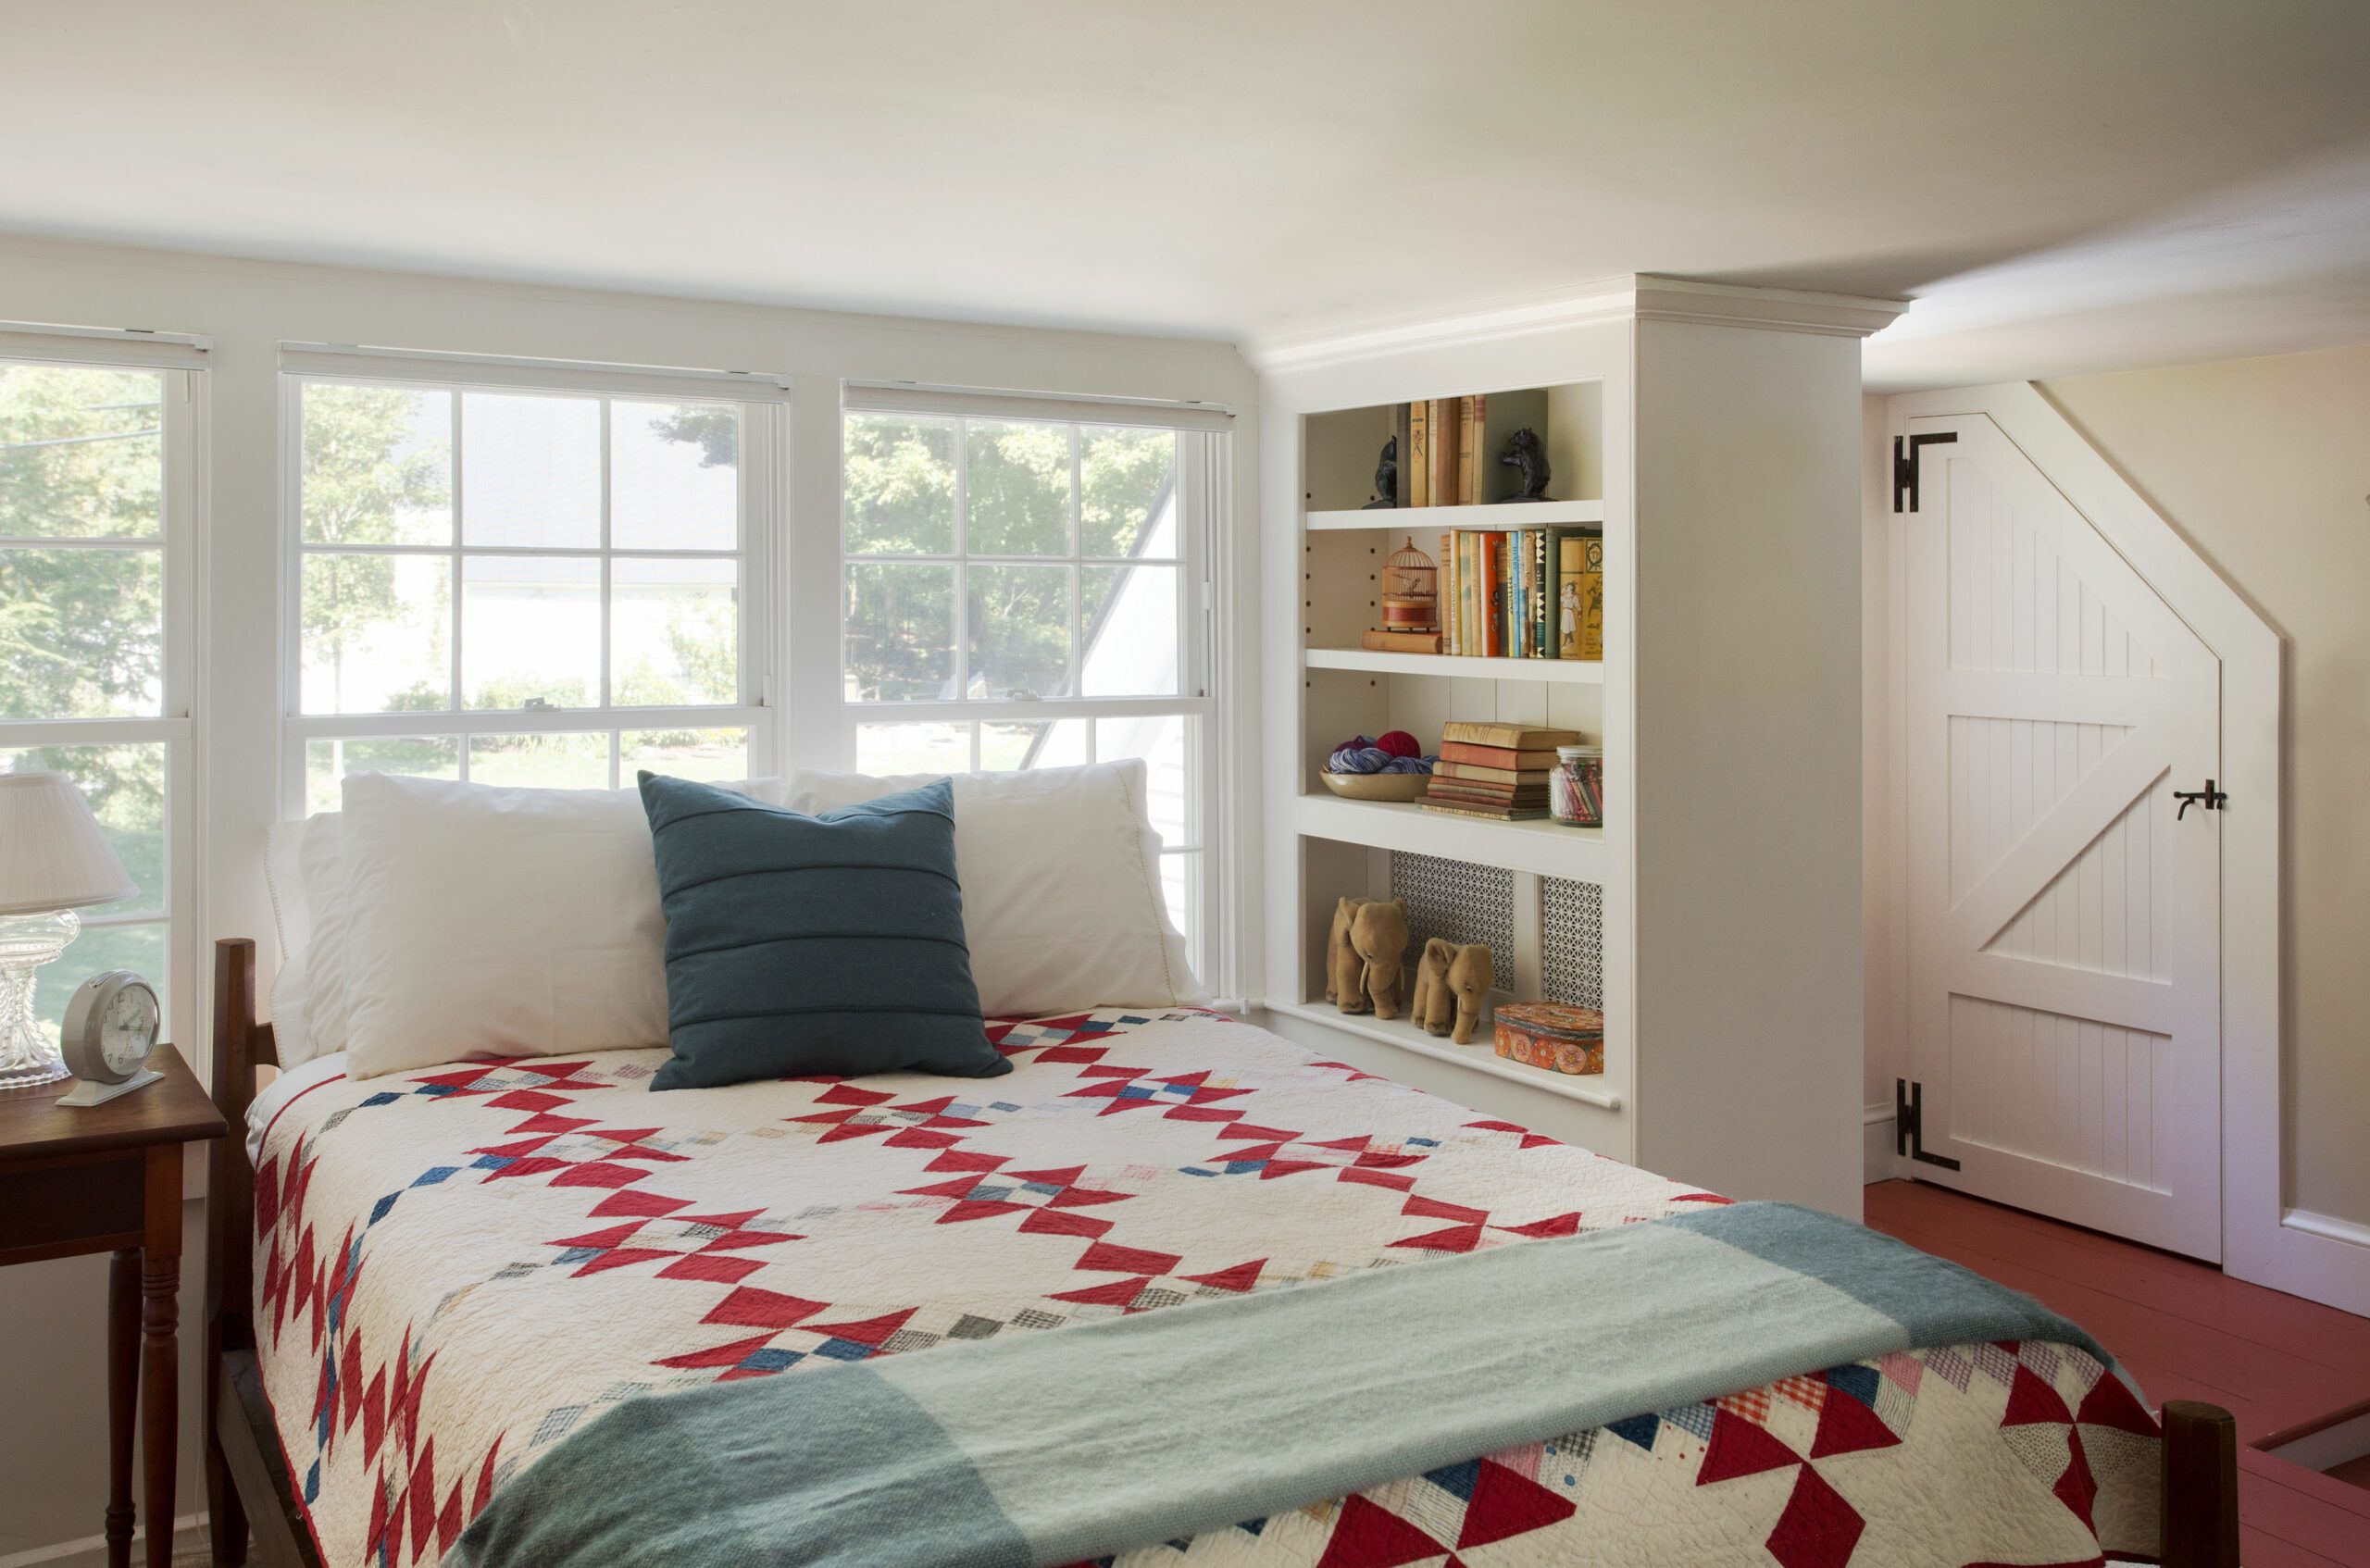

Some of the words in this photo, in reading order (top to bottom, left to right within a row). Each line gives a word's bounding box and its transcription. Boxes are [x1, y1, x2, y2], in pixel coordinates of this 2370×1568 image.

[118, 992, 126, 1003] 12
[107, 1053, 113, 1064] 7
[118, 1054, 123, 1064] 6
